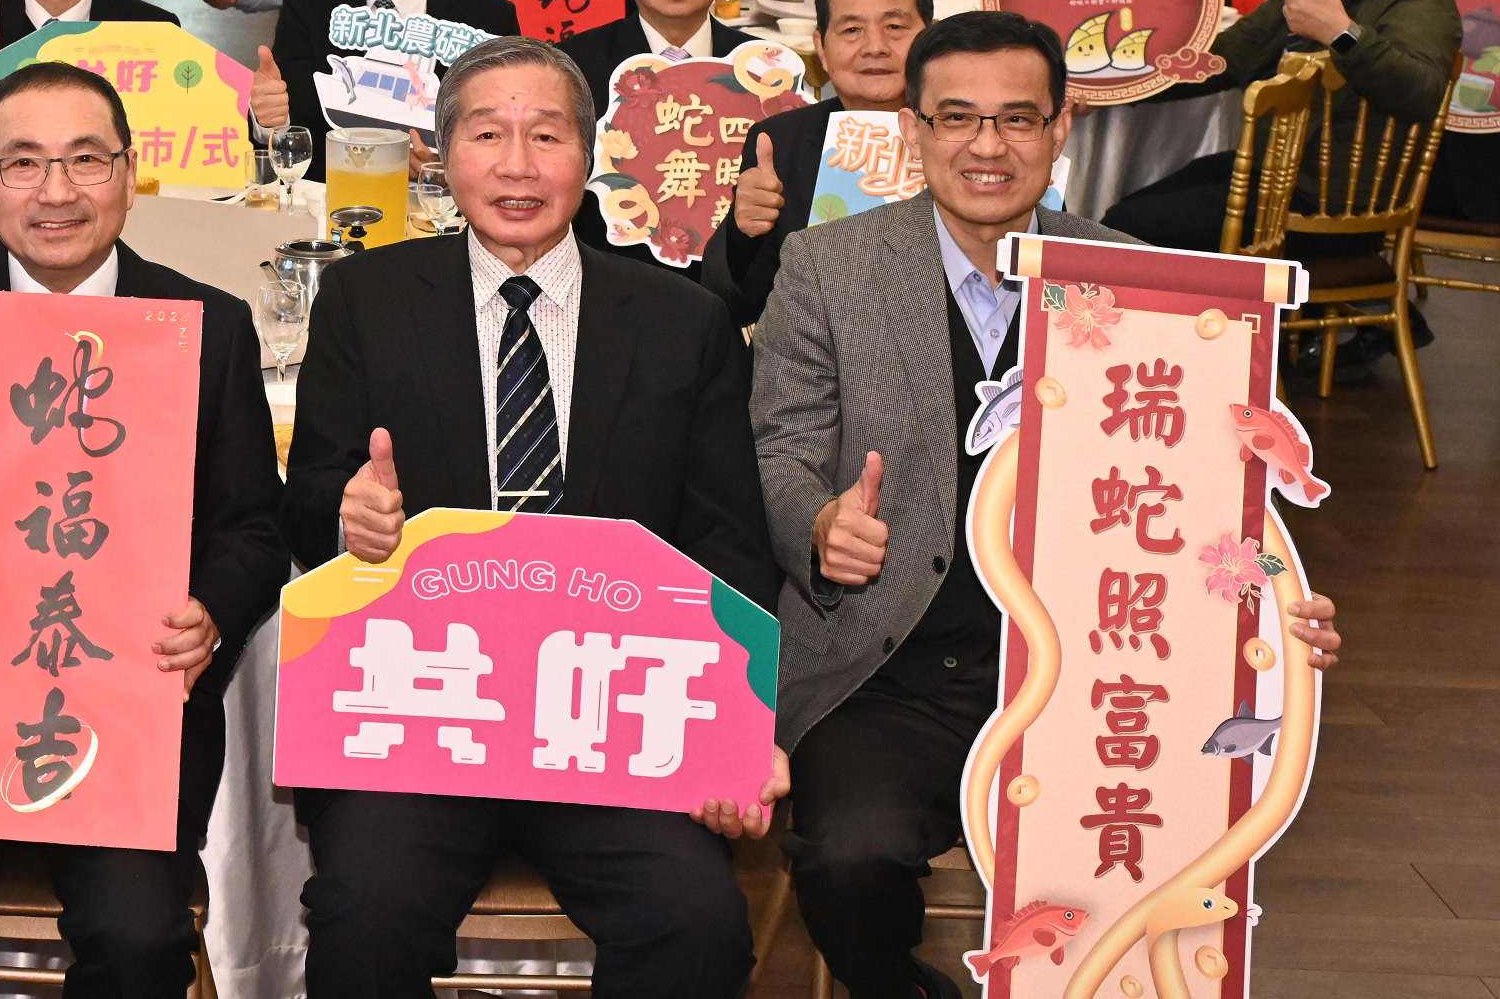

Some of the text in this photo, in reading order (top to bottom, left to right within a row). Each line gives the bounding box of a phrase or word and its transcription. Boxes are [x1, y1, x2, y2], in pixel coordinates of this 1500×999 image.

[130, 126, 239, 169] 市/式
[655, 94, 714, 208] 蛇舞
[3, 331, 127, 812] 蛇福泰吉
[411, 559, 642, 612] GUNG HO
[1080, 357, 1186, 885] 瑞蛇照富貴
[332, 618, 721, 779] 共好
